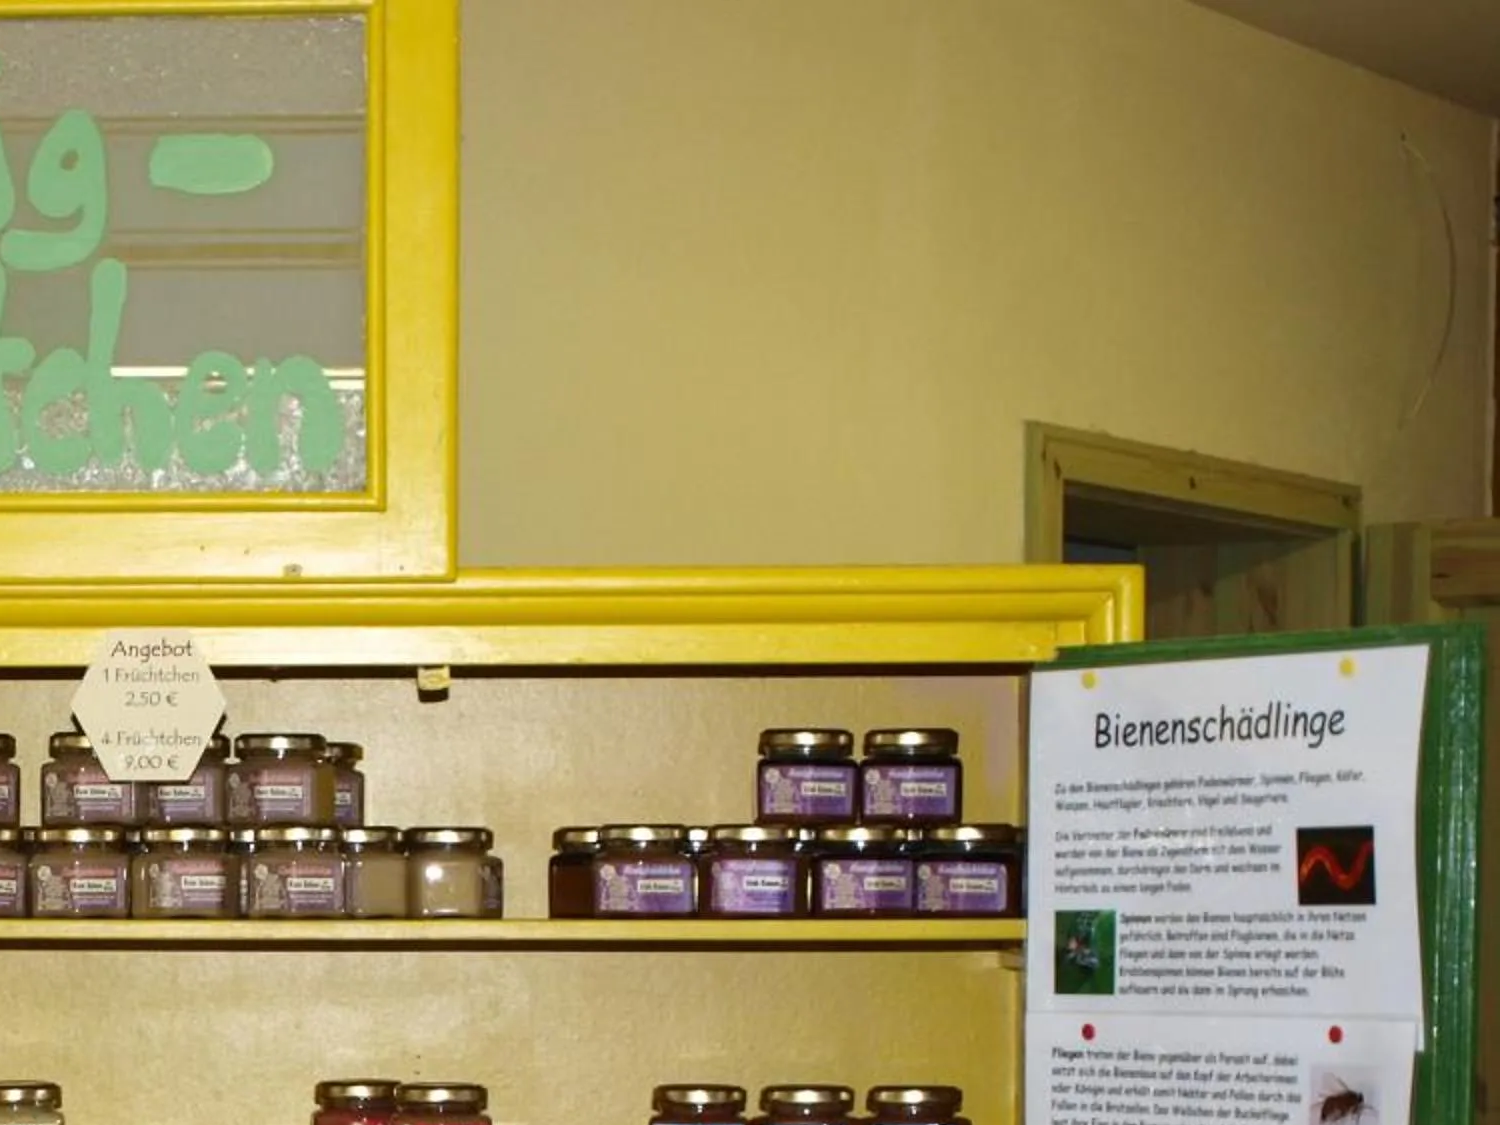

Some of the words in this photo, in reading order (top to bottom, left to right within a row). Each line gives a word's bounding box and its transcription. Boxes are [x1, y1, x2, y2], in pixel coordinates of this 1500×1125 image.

[111, 637, 193, 663] Angebot
[103, 667, 110, 683] 1
[115, 666, 200, 683] Früchtchen
[1095, 700, 1347, 750] Bienenschädlinge
[101, 733, 112, 746] 4
[117, 729, 202, 748] Früchtchen
